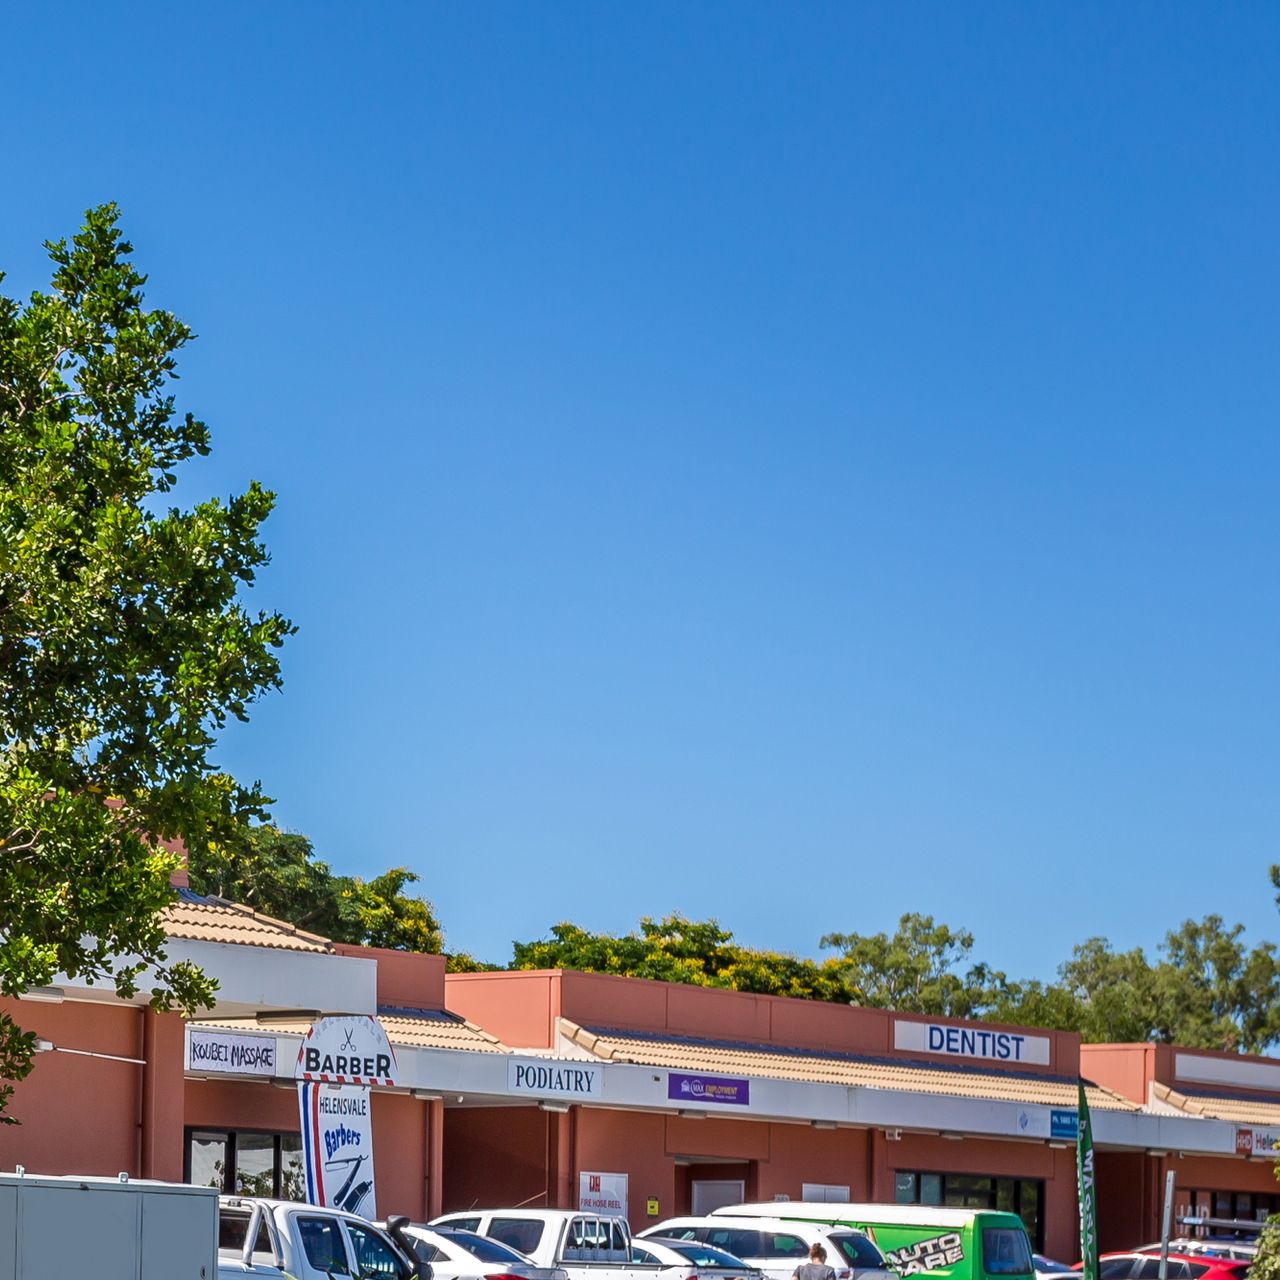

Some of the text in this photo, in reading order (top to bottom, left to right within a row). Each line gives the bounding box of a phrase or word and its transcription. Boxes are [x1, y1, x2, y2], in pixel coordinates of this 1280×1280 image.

[192, 1042, 274, 1068] KOUBEI MASSAGE
[929, 1026, 1024, 1060] DENTIST
[305, 1047, 391, 1078] BARBER
[516, 1064, 594, 1092] PODIATRY
[319, 1096, 367, 1116] HELENSVALE
[324, 1123, 361, 1160] Barbers
[607, 1200, 621, 1209] REEL
